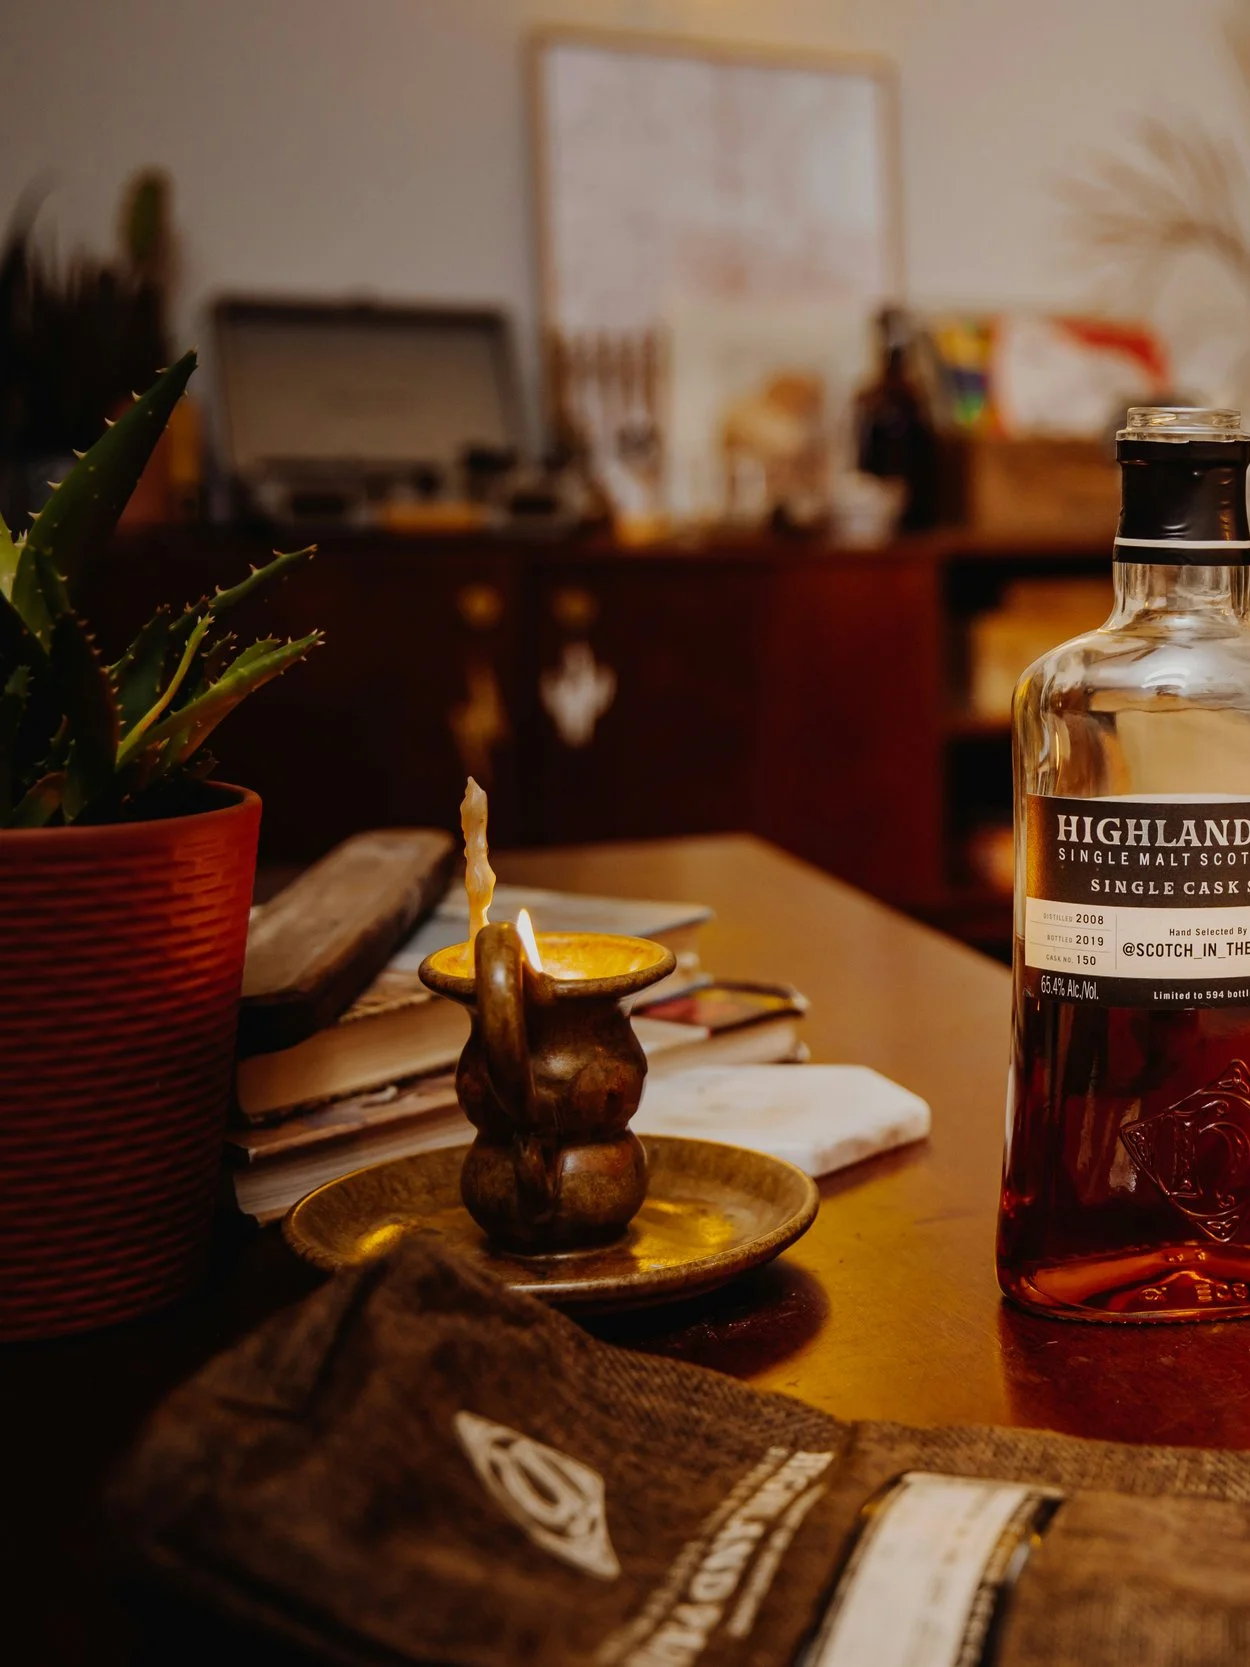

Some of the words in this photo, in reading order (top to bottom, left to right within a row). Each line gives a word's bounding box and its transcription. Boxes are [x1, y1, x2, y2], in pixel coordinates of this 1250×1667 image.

[1058, 847, 1129, 866] SINGLE
[1139, 852, 1191, 866] MALT
[1091, 878, 1175, 895] SINGLE
[1183, 881, 1240, 895] CASK
[1043, 912, 1073, 922] DISTILLED
[1076, 913, 1104, 925] 2008
[1169, 928, 1192, 936] Hand
[1195, 927, 1234, 936] Selected
[1237, 927, 1248, 936] By
[1047, 934, 1073, 943] BOTTLED
[1076, 934, 1104, 946] 2019
[1045, 954, 1062, 962] CASK
[1077, 955, 1096, 965] 150
[1041, 975, 1066, 996] 65.4%
[1067, 979, 1099, 1000] Alc./Vol.
[1153, 991, 1191, 1000] Limited
[1193, 991, 1203, 1000] to
[1206, 991, 1224, 999] 594
